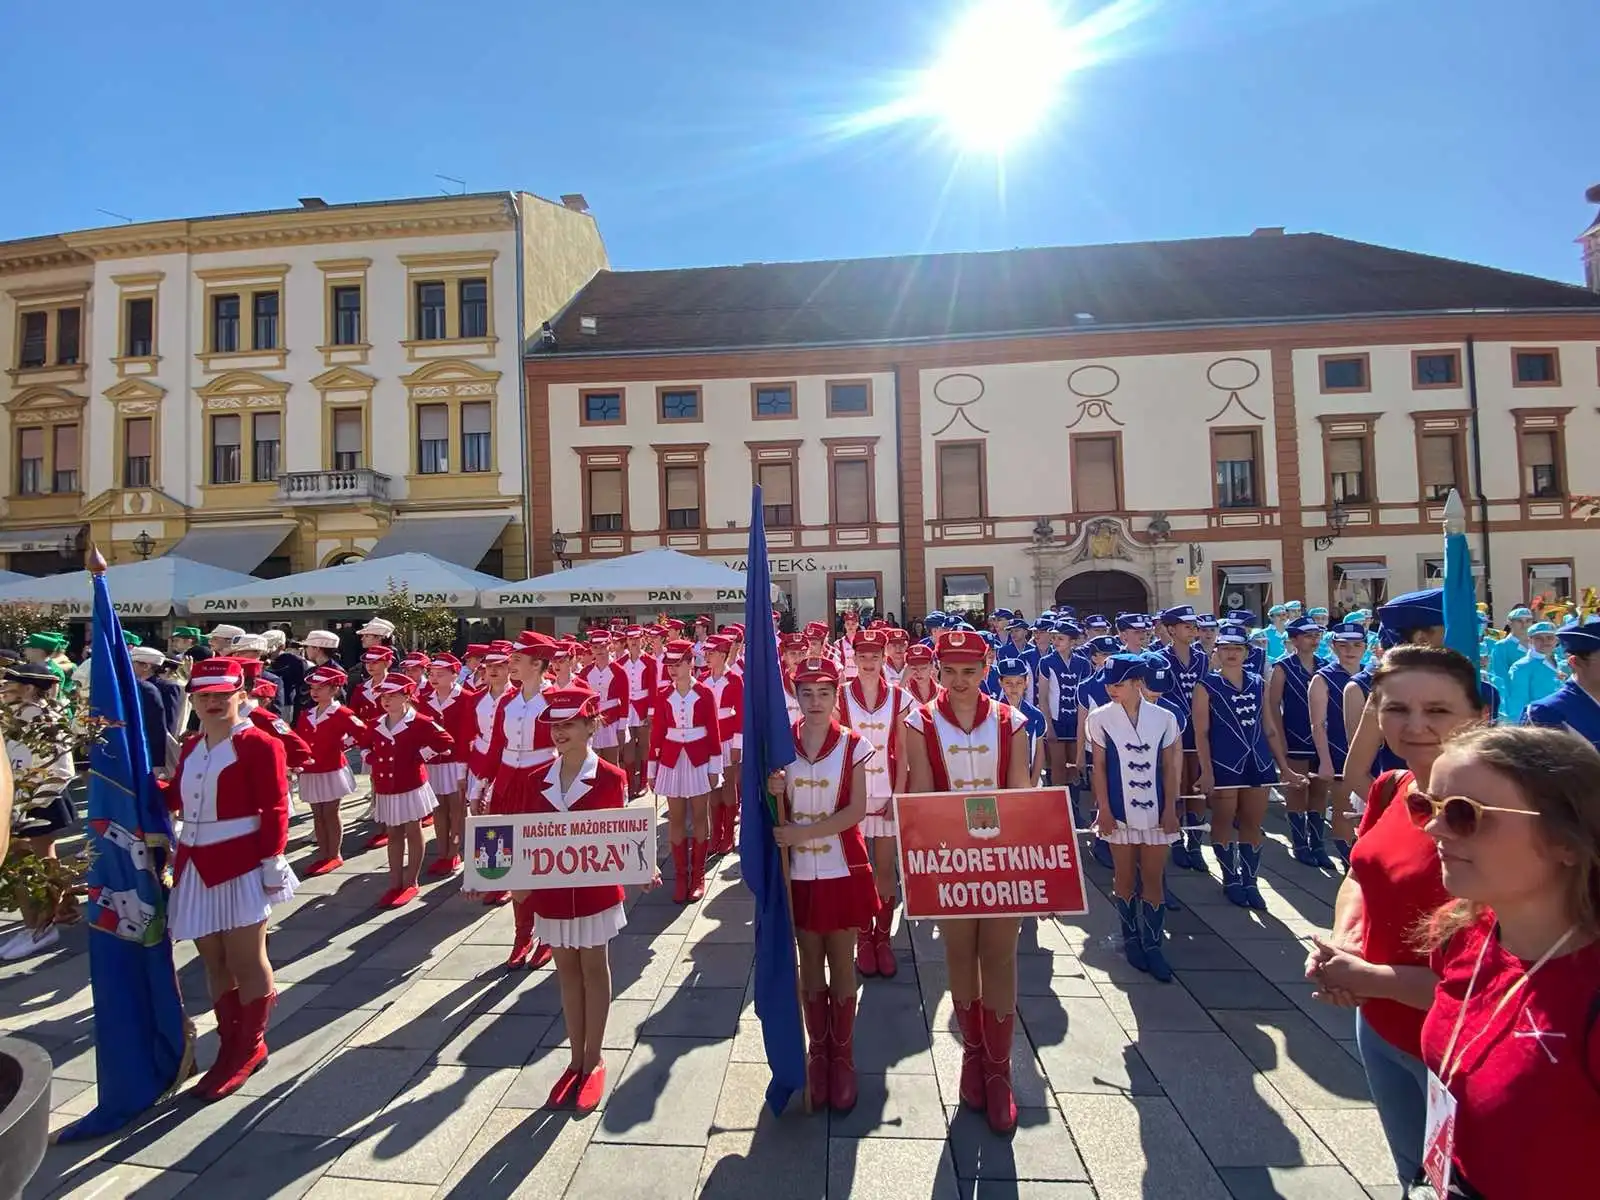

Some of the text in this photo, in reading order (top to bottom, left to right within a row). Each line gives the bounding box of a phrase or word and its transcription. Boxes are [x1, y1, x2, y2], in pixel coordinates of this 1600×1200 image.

[204, 593, 447, 610] PAN PAN PAN PAN
[500, 590, 747, 604] PAN PAN PAN PAN
[523, 819, 648, 838] NAŠIČKE MAŽORETKINJE
[523, 843, 630, 875] "DORA"
[908, 842, 1072, 874] MAŽORETKINJE
[938, 880, 1049, 908] KOTORIBE
